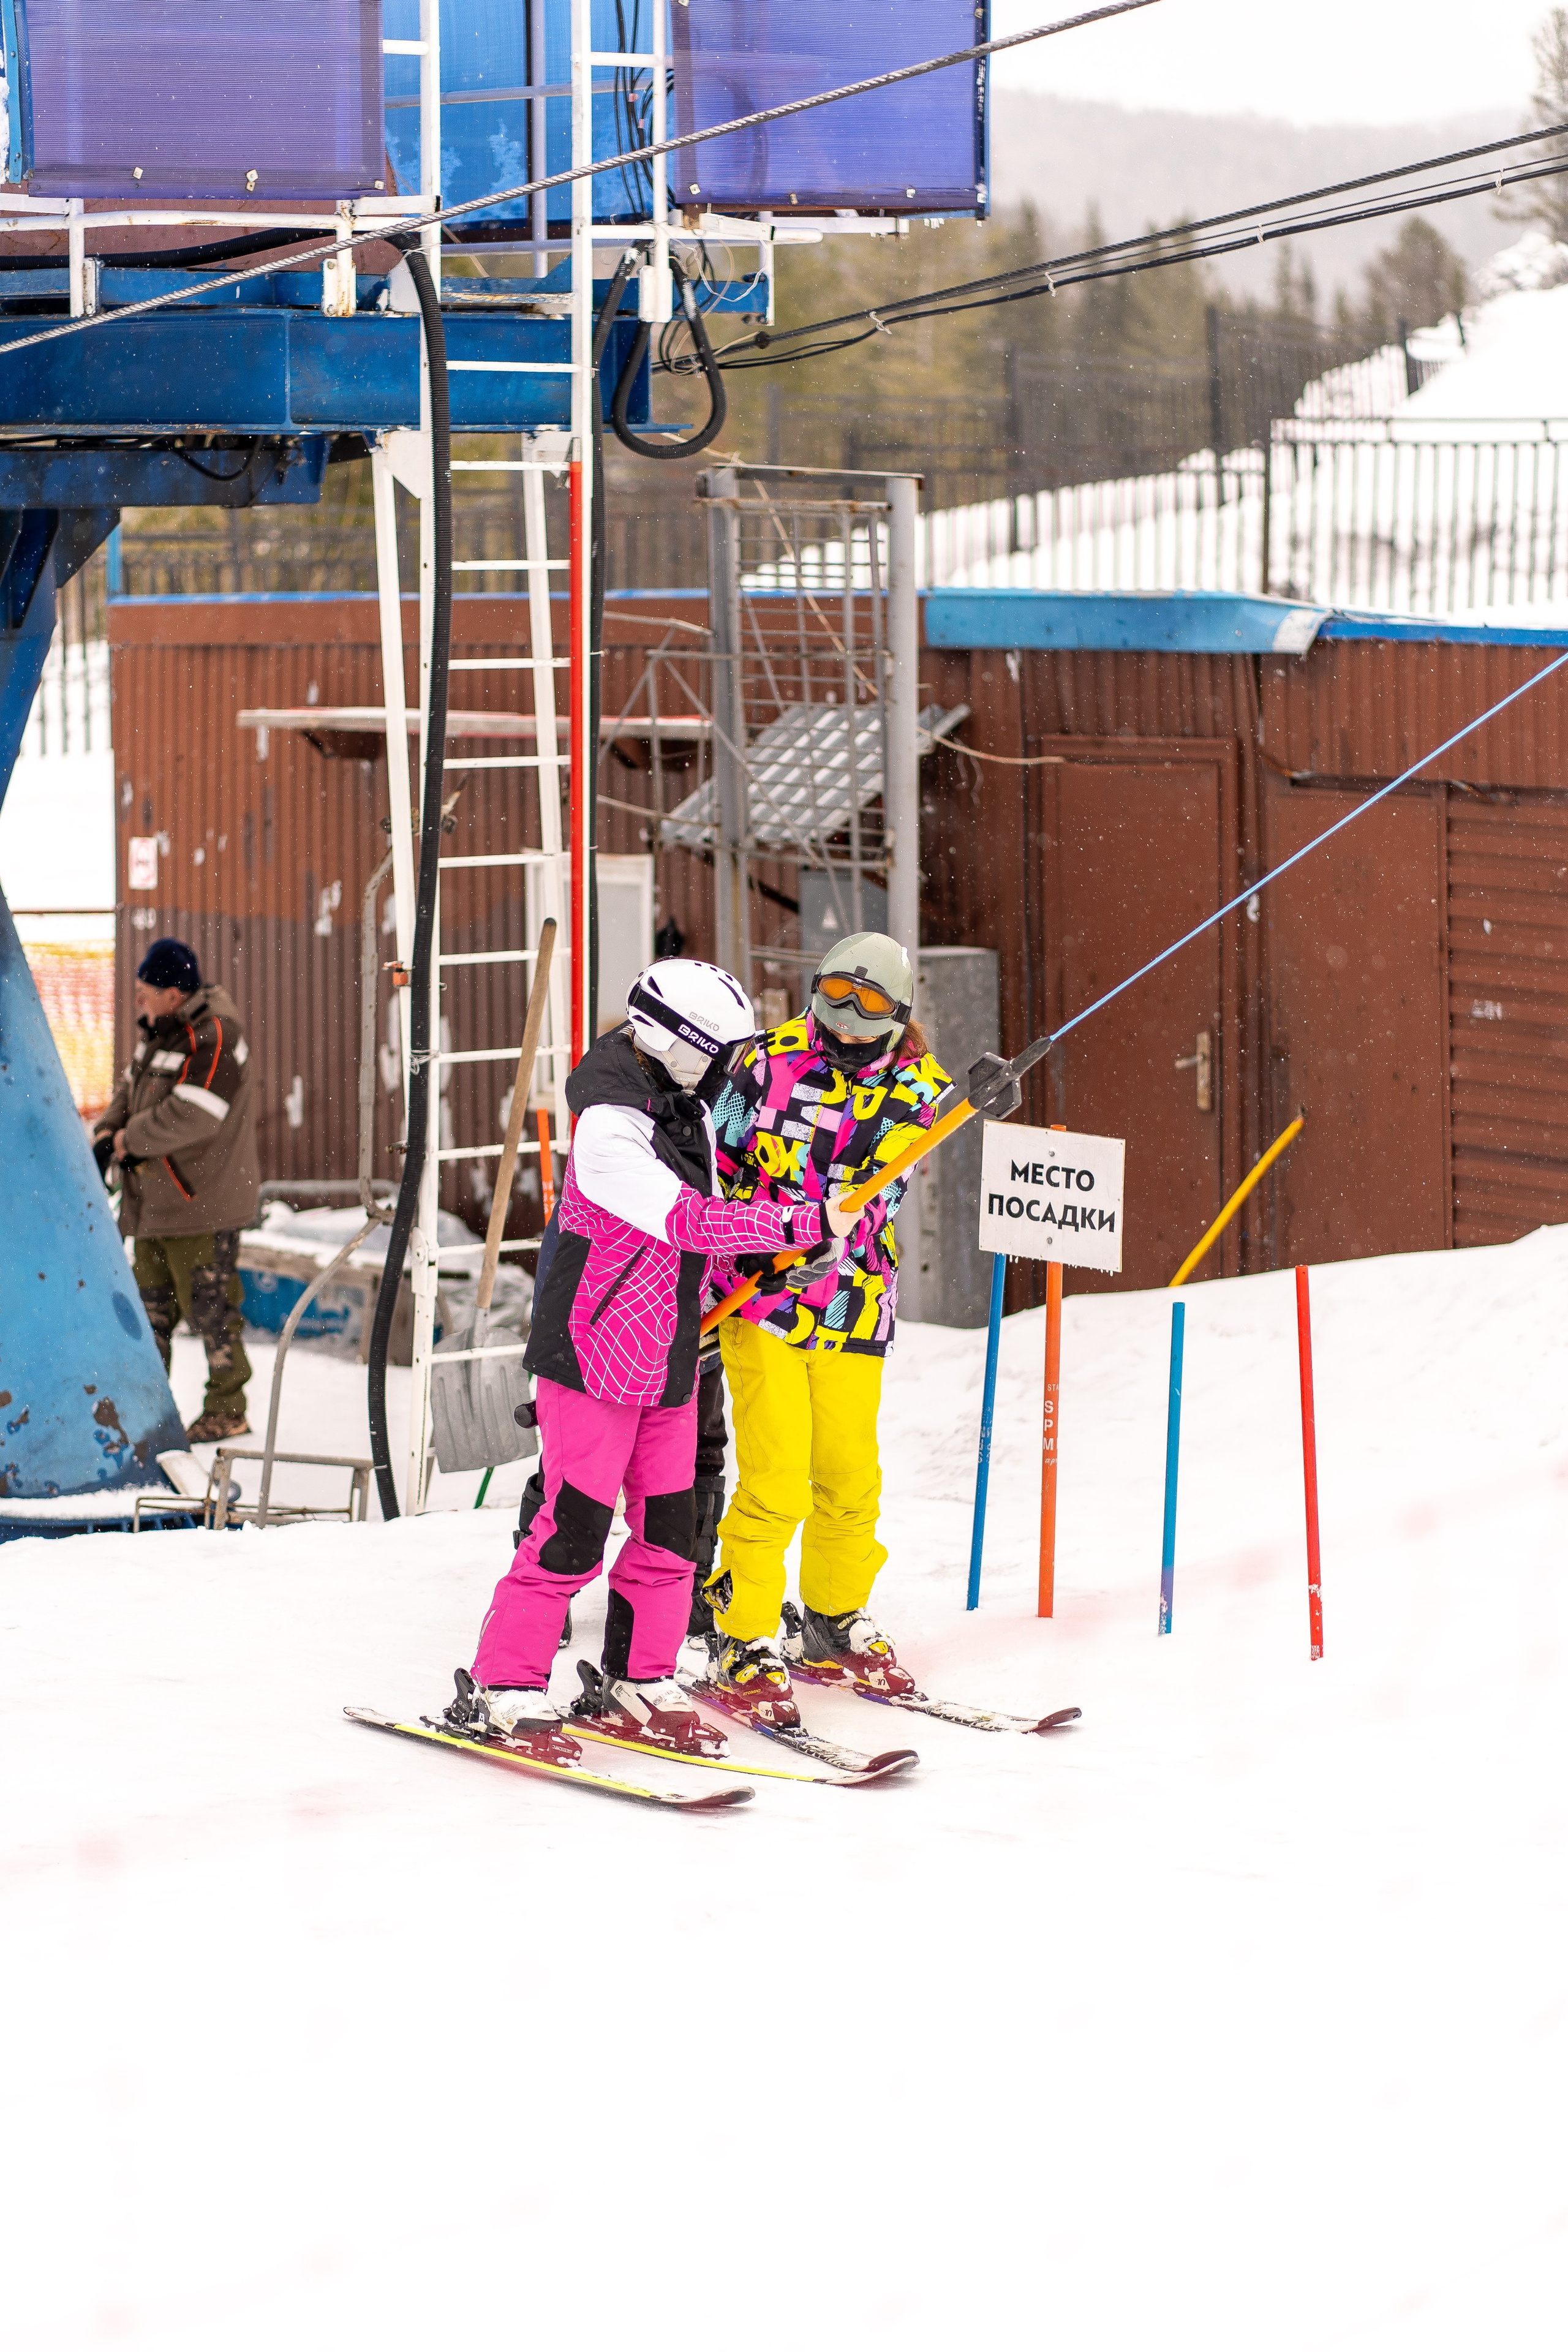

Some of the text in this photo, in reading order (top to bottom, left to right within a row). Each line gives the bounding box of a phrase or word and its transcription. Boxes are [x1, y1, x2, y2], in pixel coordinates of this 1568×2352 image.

[688, 1011, 720, 1031] BRIKO
[677, 1023, 719, 1054] BRIKO
[1011, 1159, 1095, 1191] МЕСТО
[988, 1193, 1115, 1232] ПОСАДКИ
